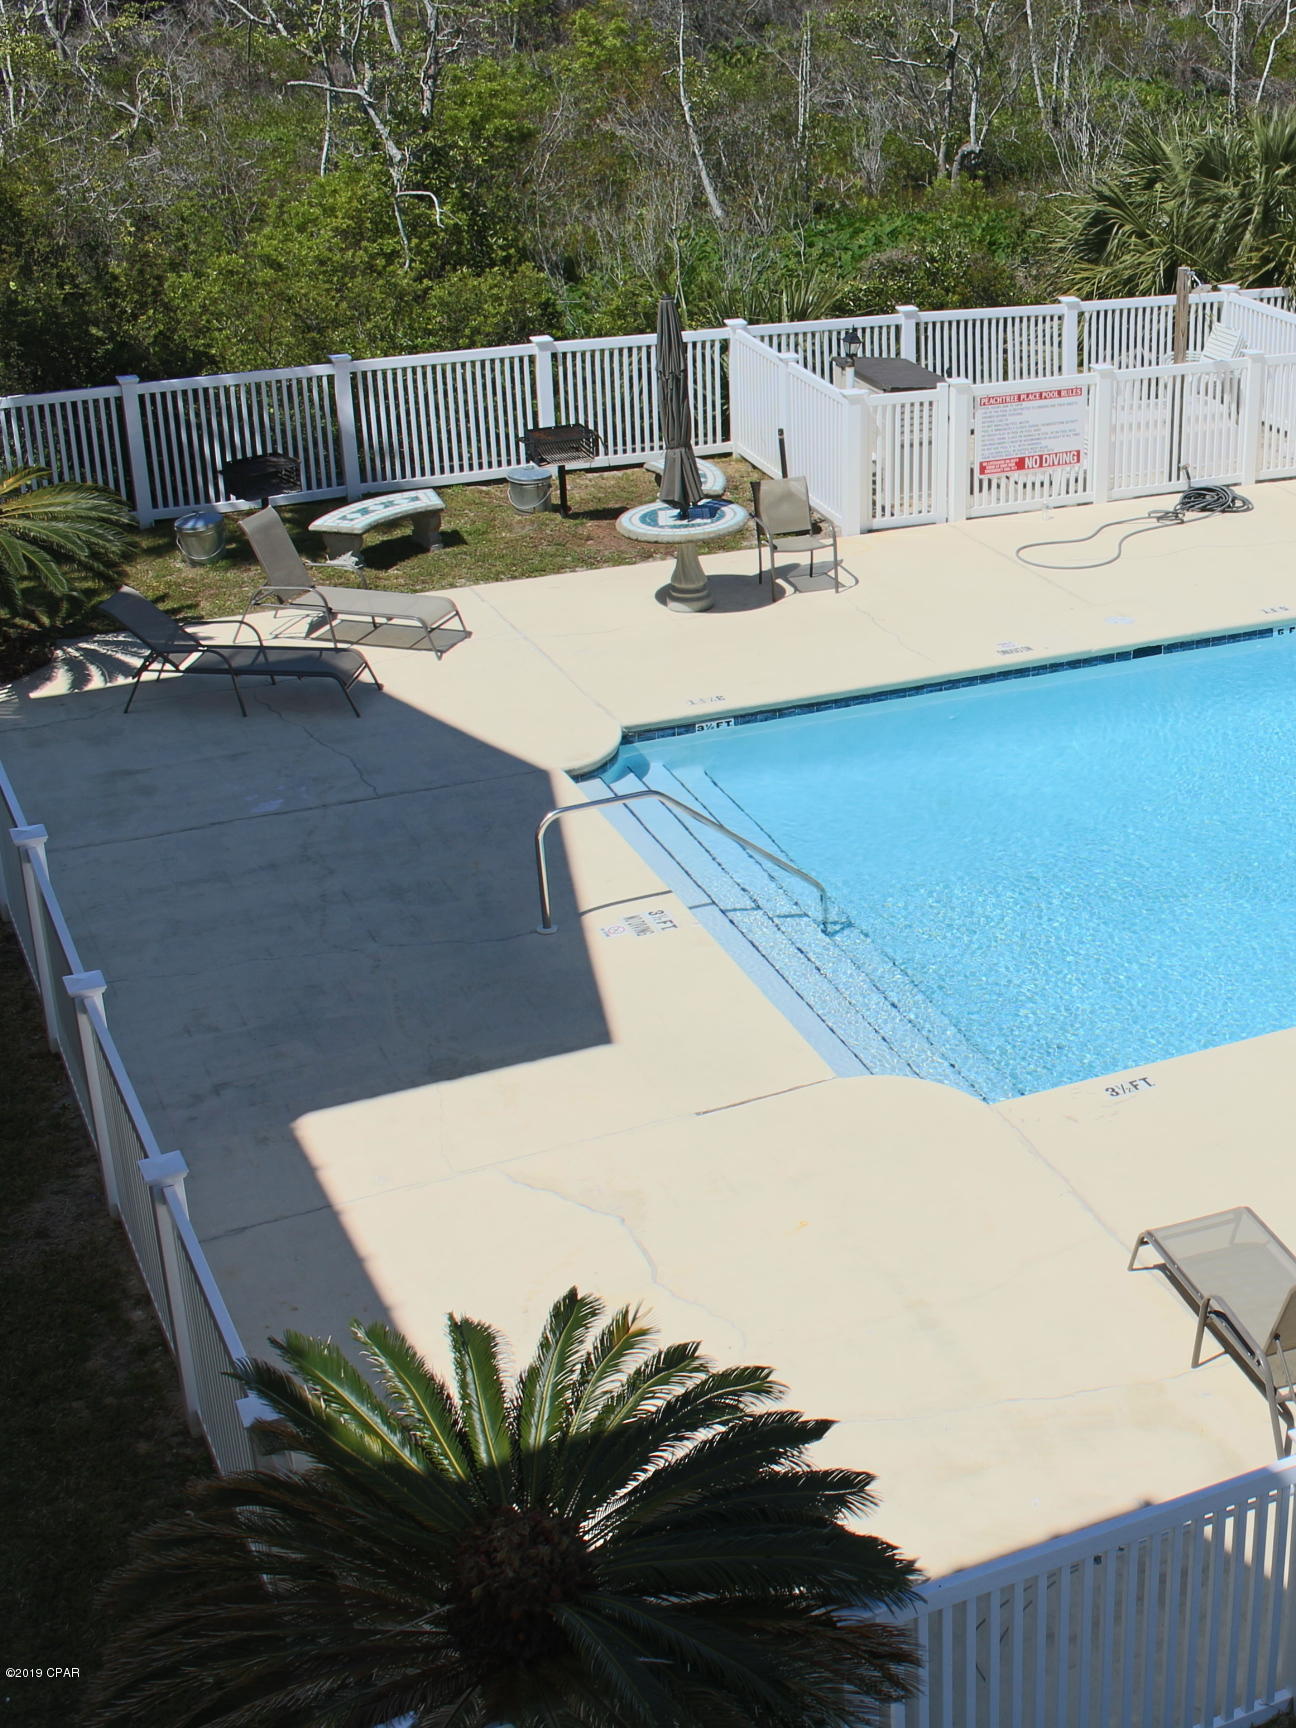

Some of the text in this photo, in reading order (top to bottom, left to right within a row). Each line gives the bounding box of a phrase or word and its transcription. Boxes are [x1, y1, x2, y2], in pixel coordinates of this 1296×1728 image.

[981, 388, 1081, 405] PEACHTREE PLACE POOL RULES
[1024, 456, 1040, 469] NO
[1042, 451, 1077, 467] DIVING
